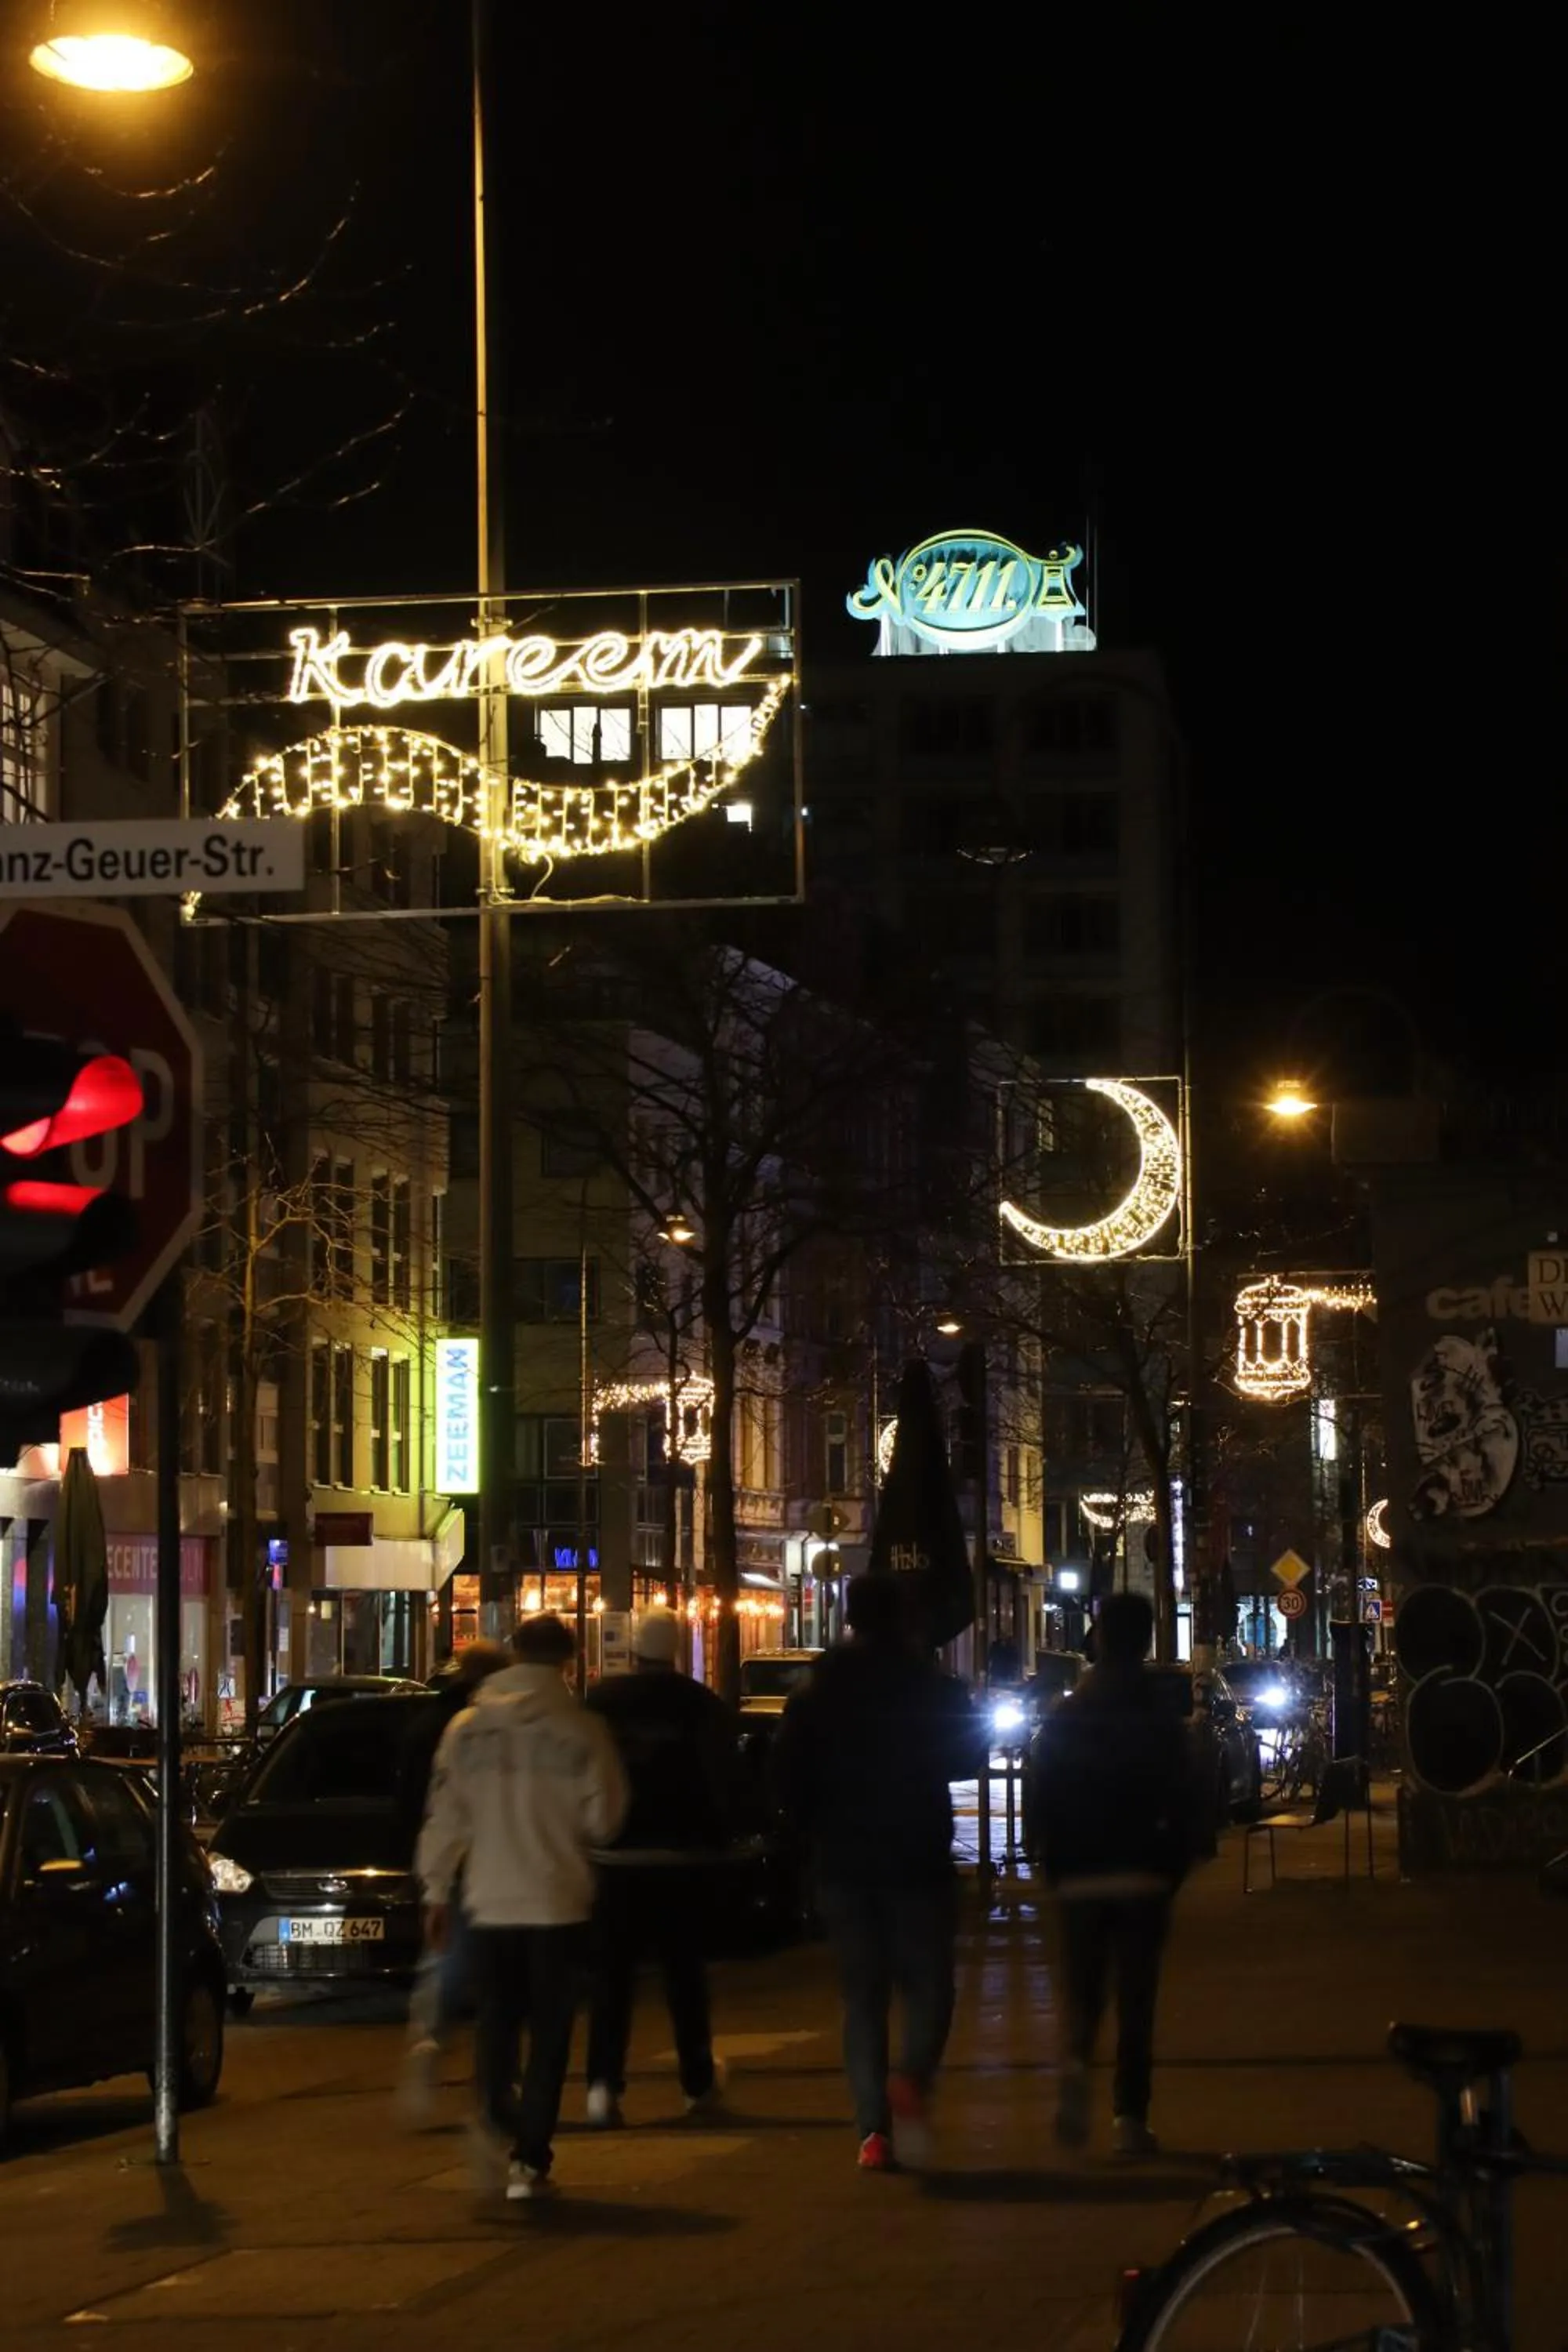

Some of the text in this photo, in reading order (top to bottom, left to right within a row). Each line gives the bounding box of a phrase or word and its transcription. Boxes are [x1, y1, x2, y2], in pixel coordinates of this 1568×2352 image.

[288, 627, 763, 707] Kareem
[0, 833, 274, 884] nz-Geuer-Str.
[1538, 1258, 1568, 1284] D
[446, 1348, 468, 1483] ZEEMAN
[107, 1544, 158, 1579] ECENTE
[1283, 1595, 1299, 1610] 30
[291, 1921, 313, 1939] BM
[350, 1920, 381, 1937] 647
